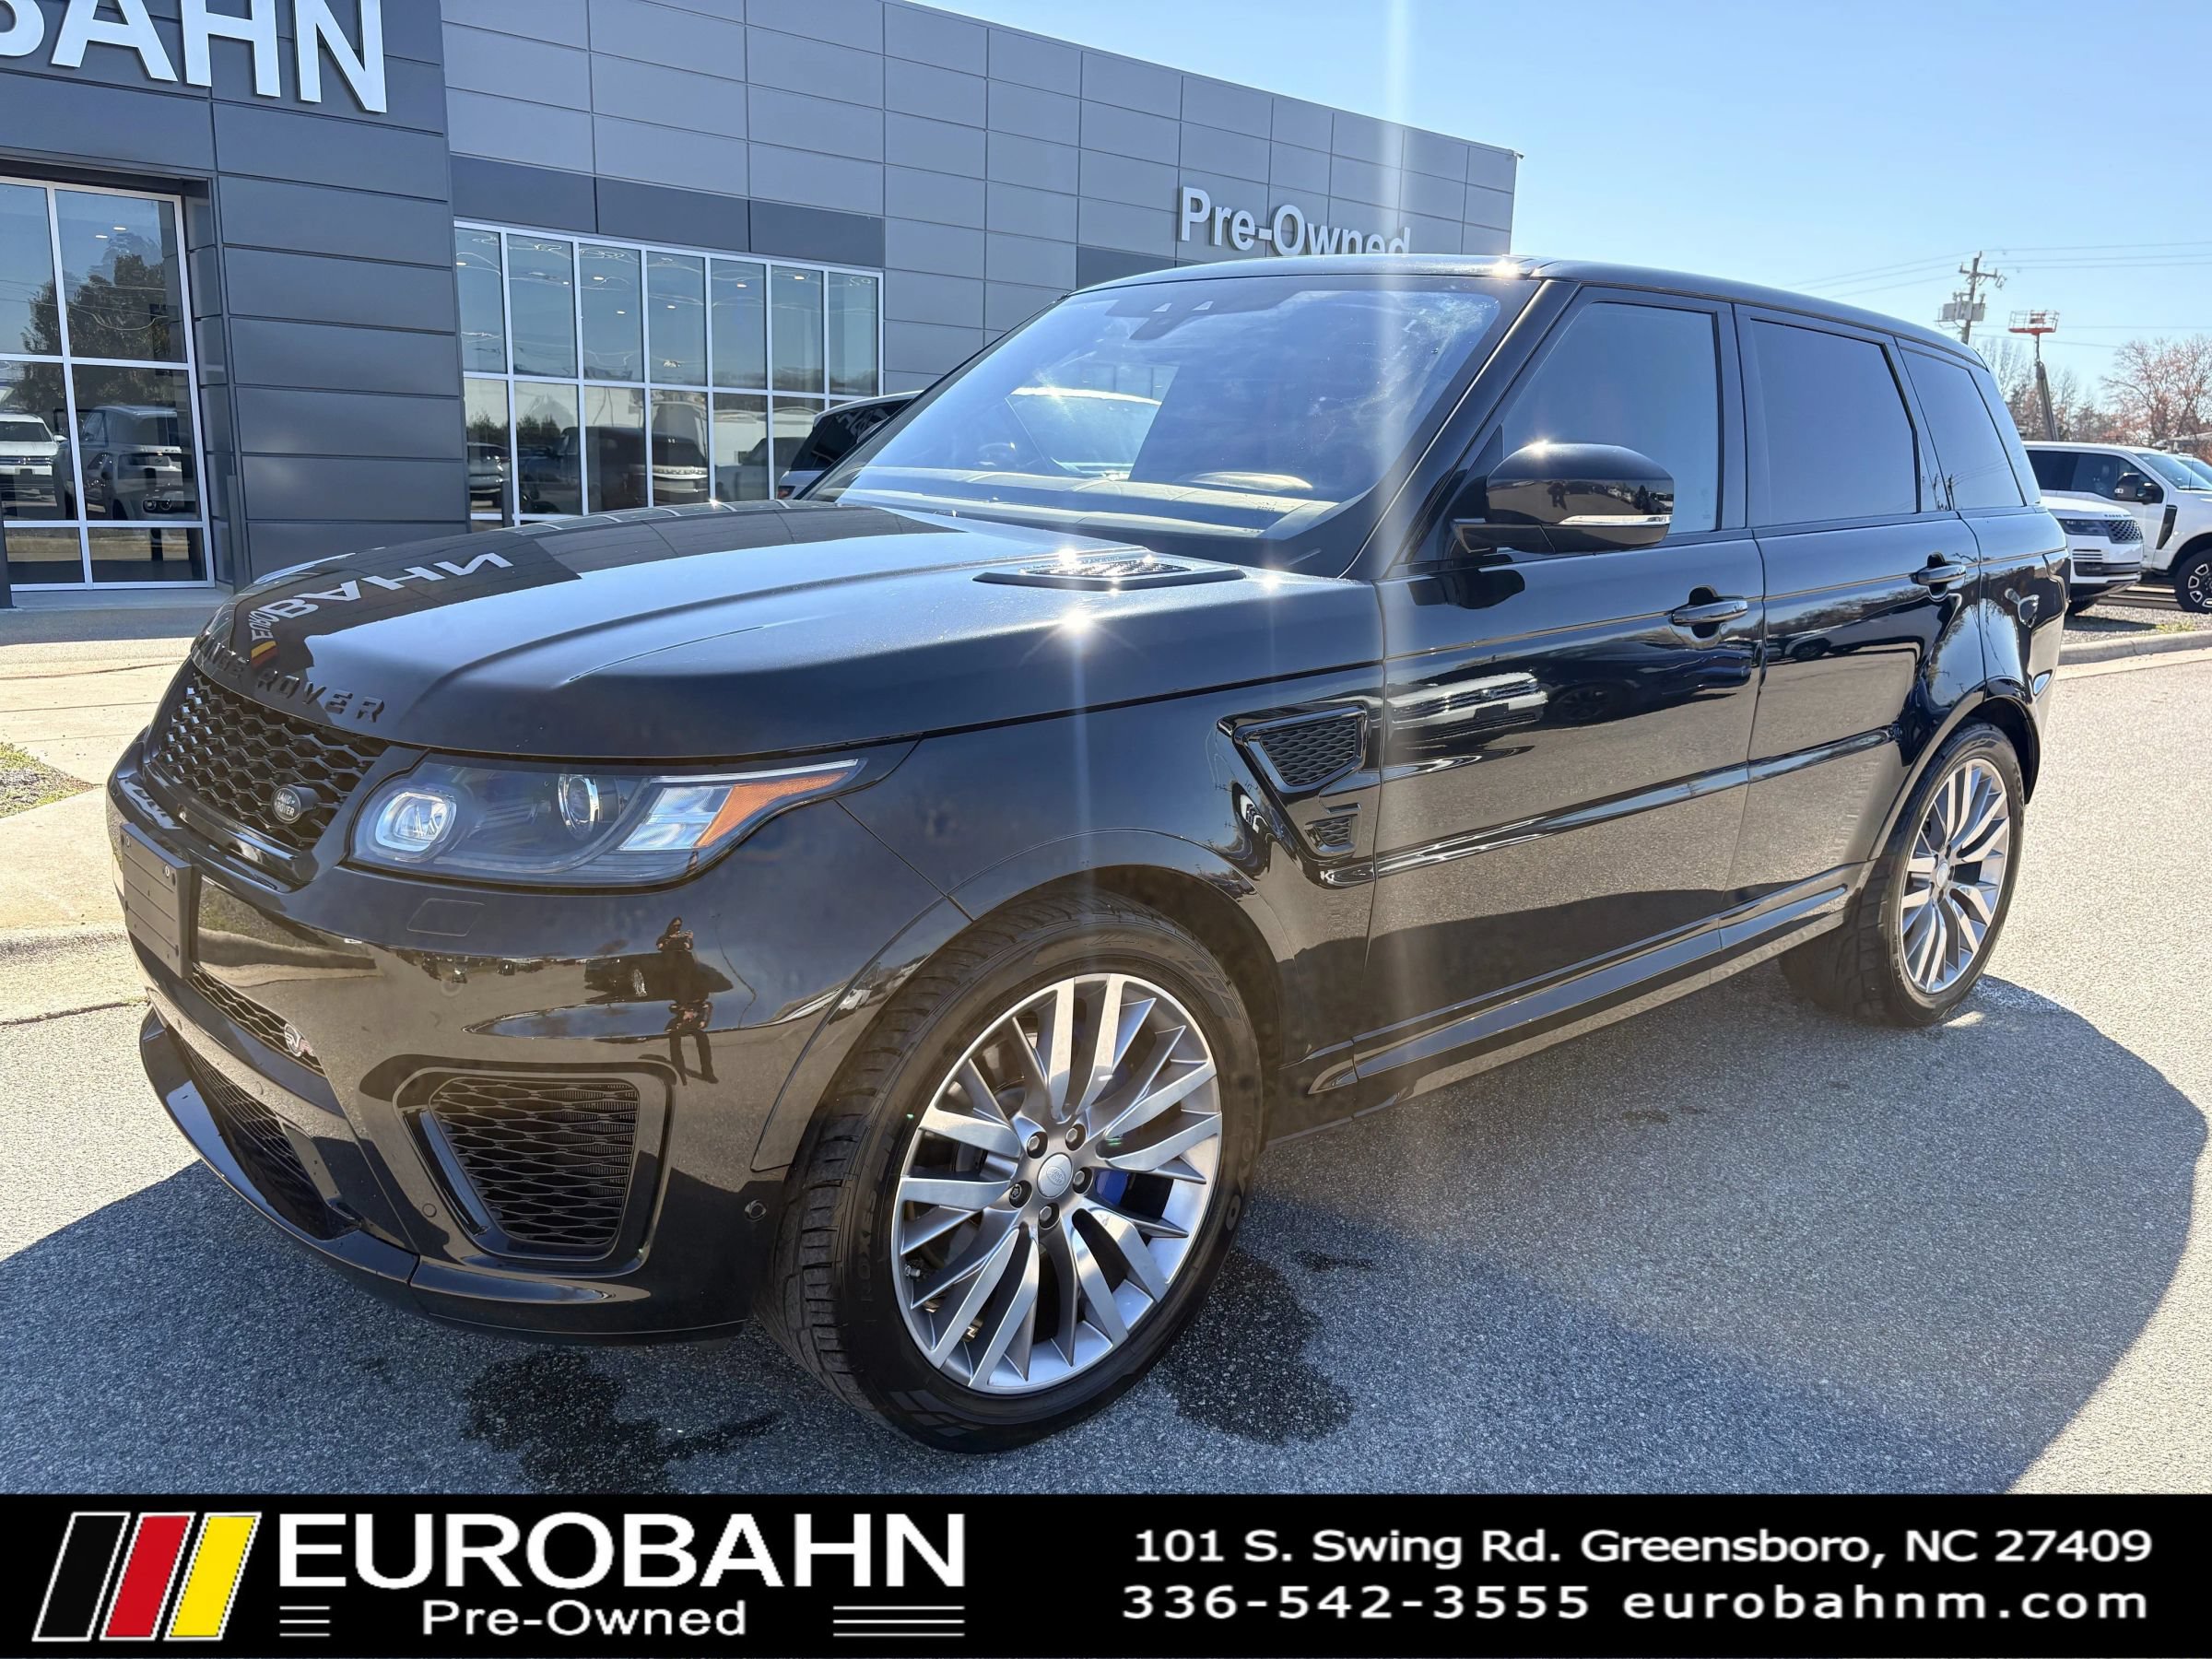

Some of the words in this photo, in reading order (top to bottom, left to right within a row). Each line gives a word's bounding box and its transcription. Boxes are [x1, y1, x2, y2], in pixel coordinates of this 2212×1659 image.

[0, 0, 387, 113] AHN
[1180, 185, 1411, 256] Pre-Owned
[254, 669, 385, 723] ROVER
